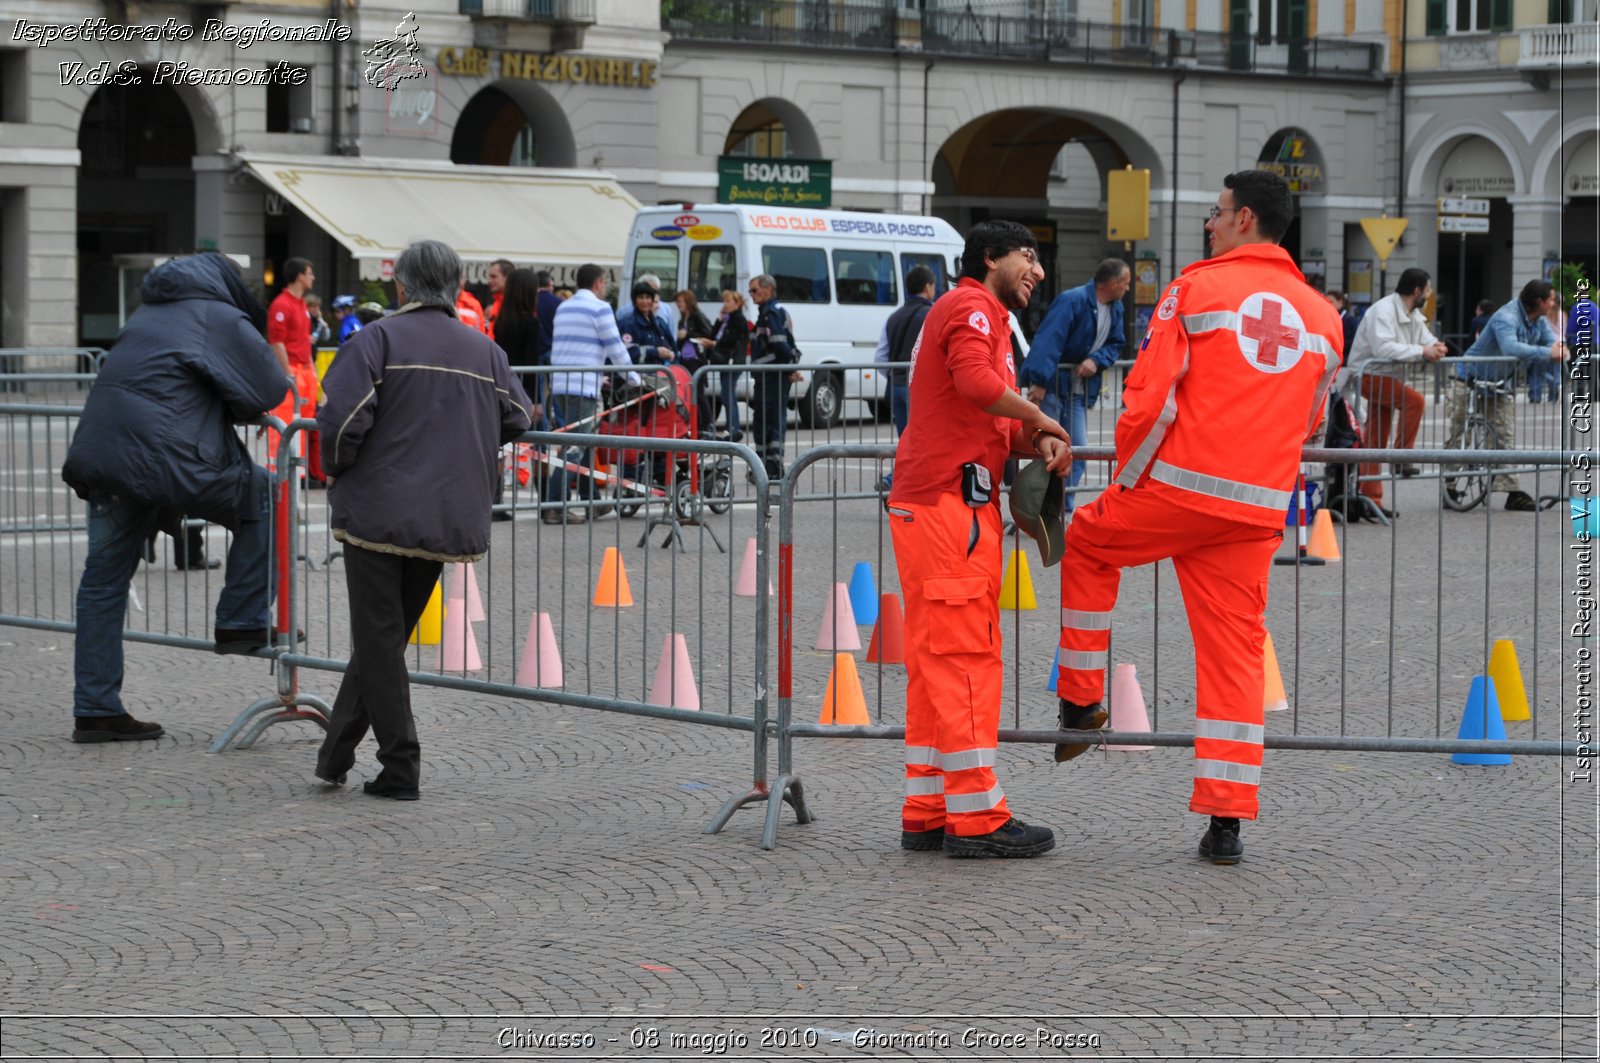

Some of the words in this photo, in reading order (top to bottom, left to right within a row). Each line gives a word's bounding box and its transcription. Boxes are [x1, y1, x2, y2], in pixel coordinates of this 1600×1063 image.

[502, 52, 657, 87] NAZIONALE
[743, 163, 810, 183] ISOARDI
[750, 214, 788, 229] VELO
[789, 217, 827, 232] CLUB
[831, 219, 886, 234] ESPERIA
[888, 223, 935, 238] PIASCO
